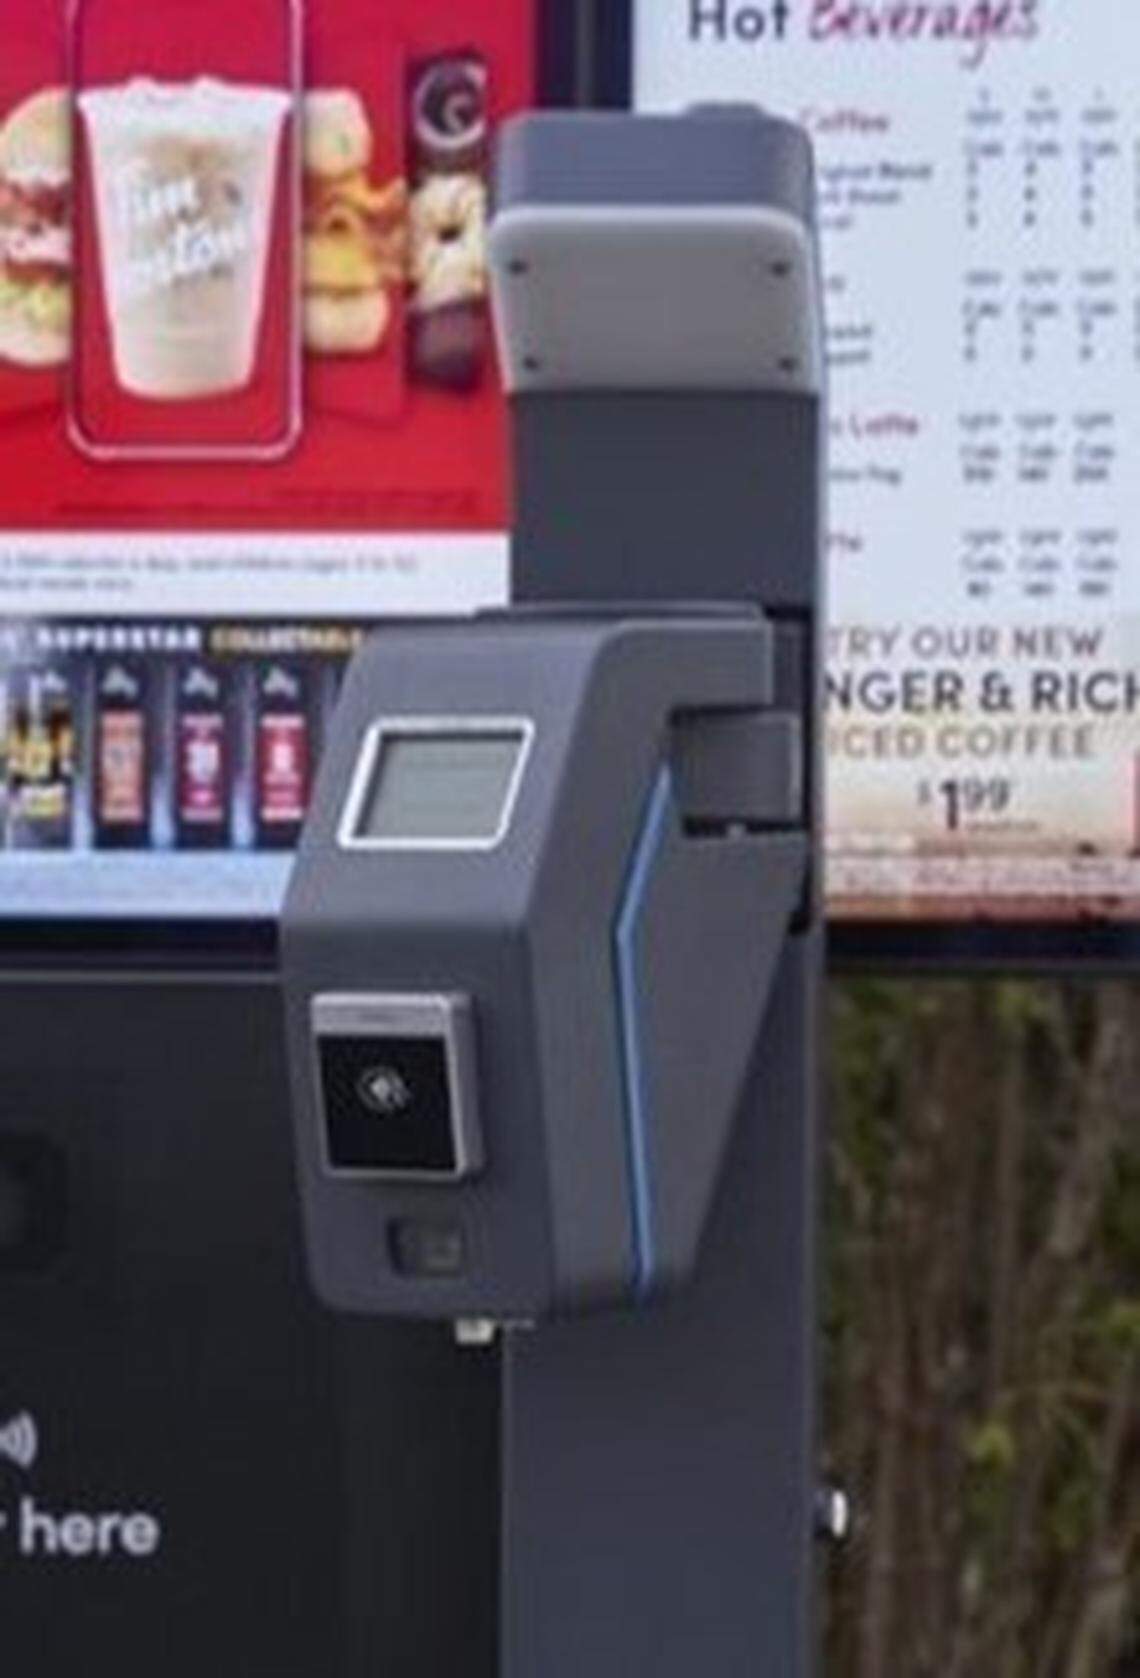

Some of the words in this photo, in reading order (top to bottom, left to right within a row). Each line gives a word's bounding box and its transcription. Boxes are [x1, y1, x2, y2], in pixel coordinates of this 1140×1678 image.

[688, 0, 788, 41] Hot
[808, 0, 1039, 71] Beverages
[825, 625, 900, 659] TRY
[910, 625, 999, 659] OUR
[1013, 625, 1103, 659] NEW
[978, 670, 1014, 713] &
[937, 724, 1094, 760] COFFEE
[20, 1494, 159, 1556] here
